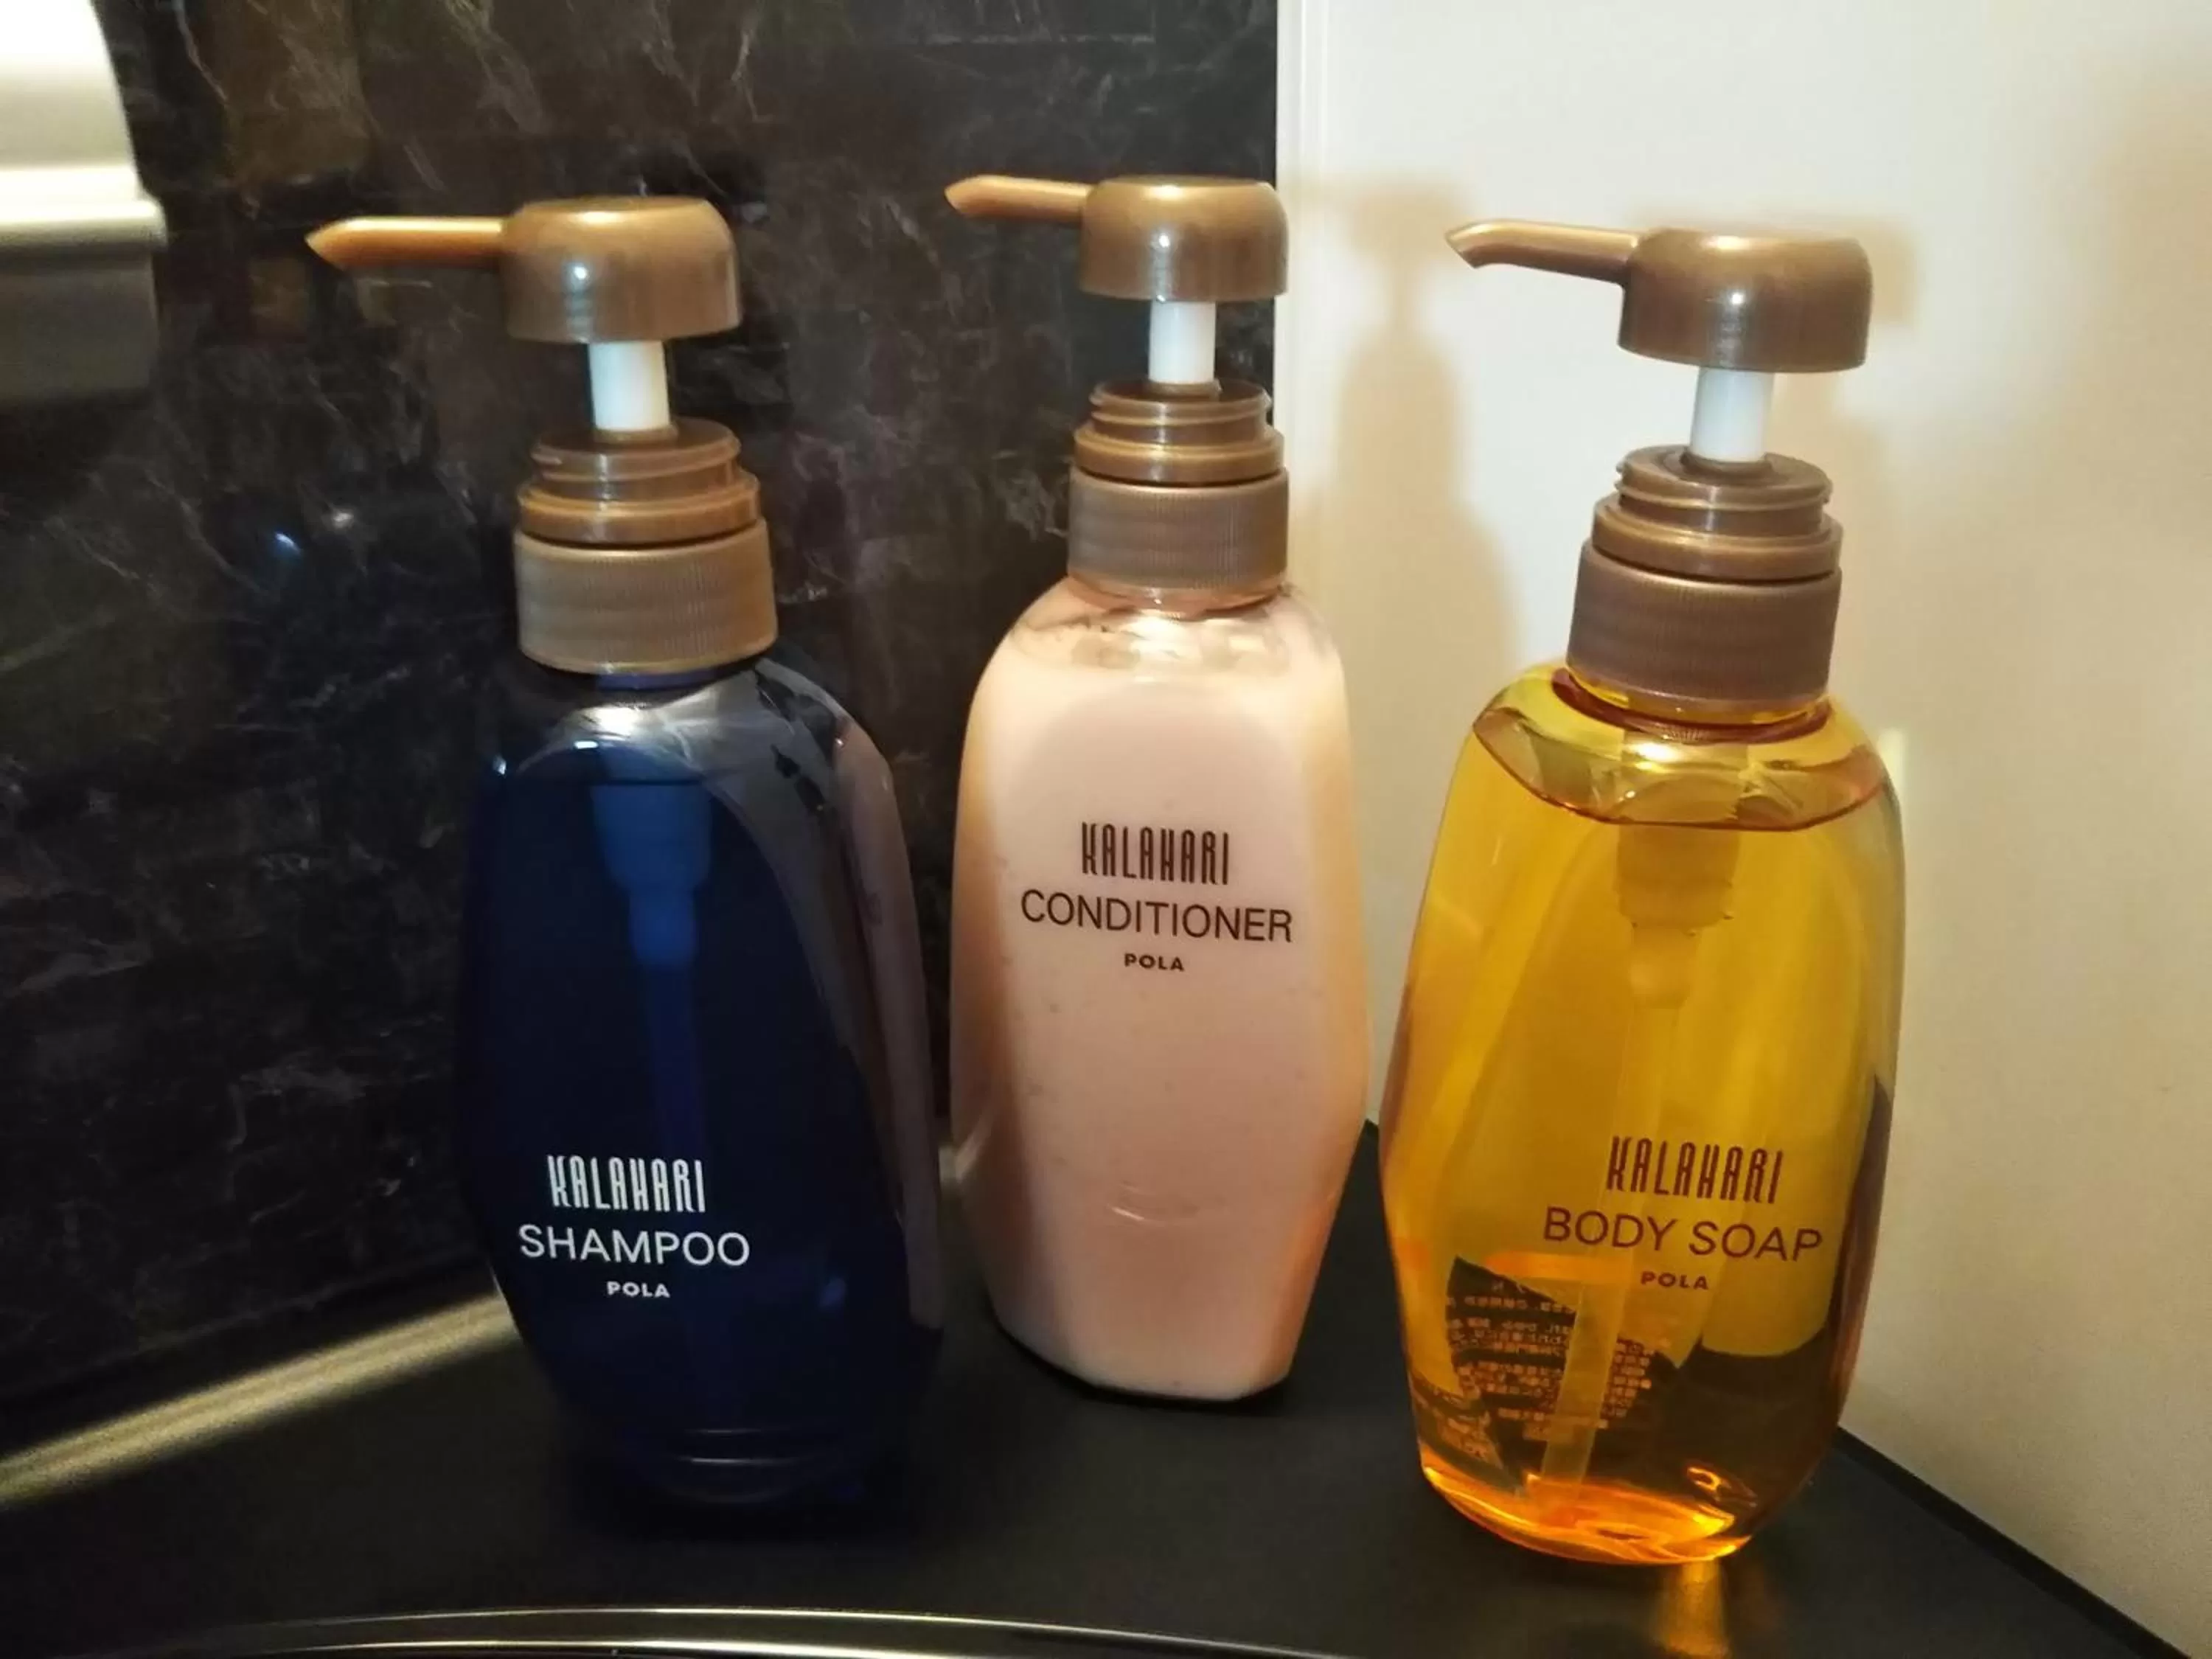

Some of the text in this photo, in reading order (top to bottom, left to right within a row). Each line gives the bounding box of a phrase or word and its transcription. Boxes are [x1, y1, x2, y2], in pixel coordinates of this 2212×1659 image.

[1081, 821, 1229, 885] KALAHARI
[1021, 888, 1293, 942] CONDITIONER
[1124, 953, 1185, 971] POLA
[546, 1155, 706, 1213] KALAHARI
[1606, 1135, 1784, 1204] KALAHARI
[518, 1223, 751, 1266] SHAMPOO
[1543, 1206, 1823, 1262] BODY SOAP
[606, 1281, 671, 1298] POLA
[1640, 1270, 1709, 1290] POLA
